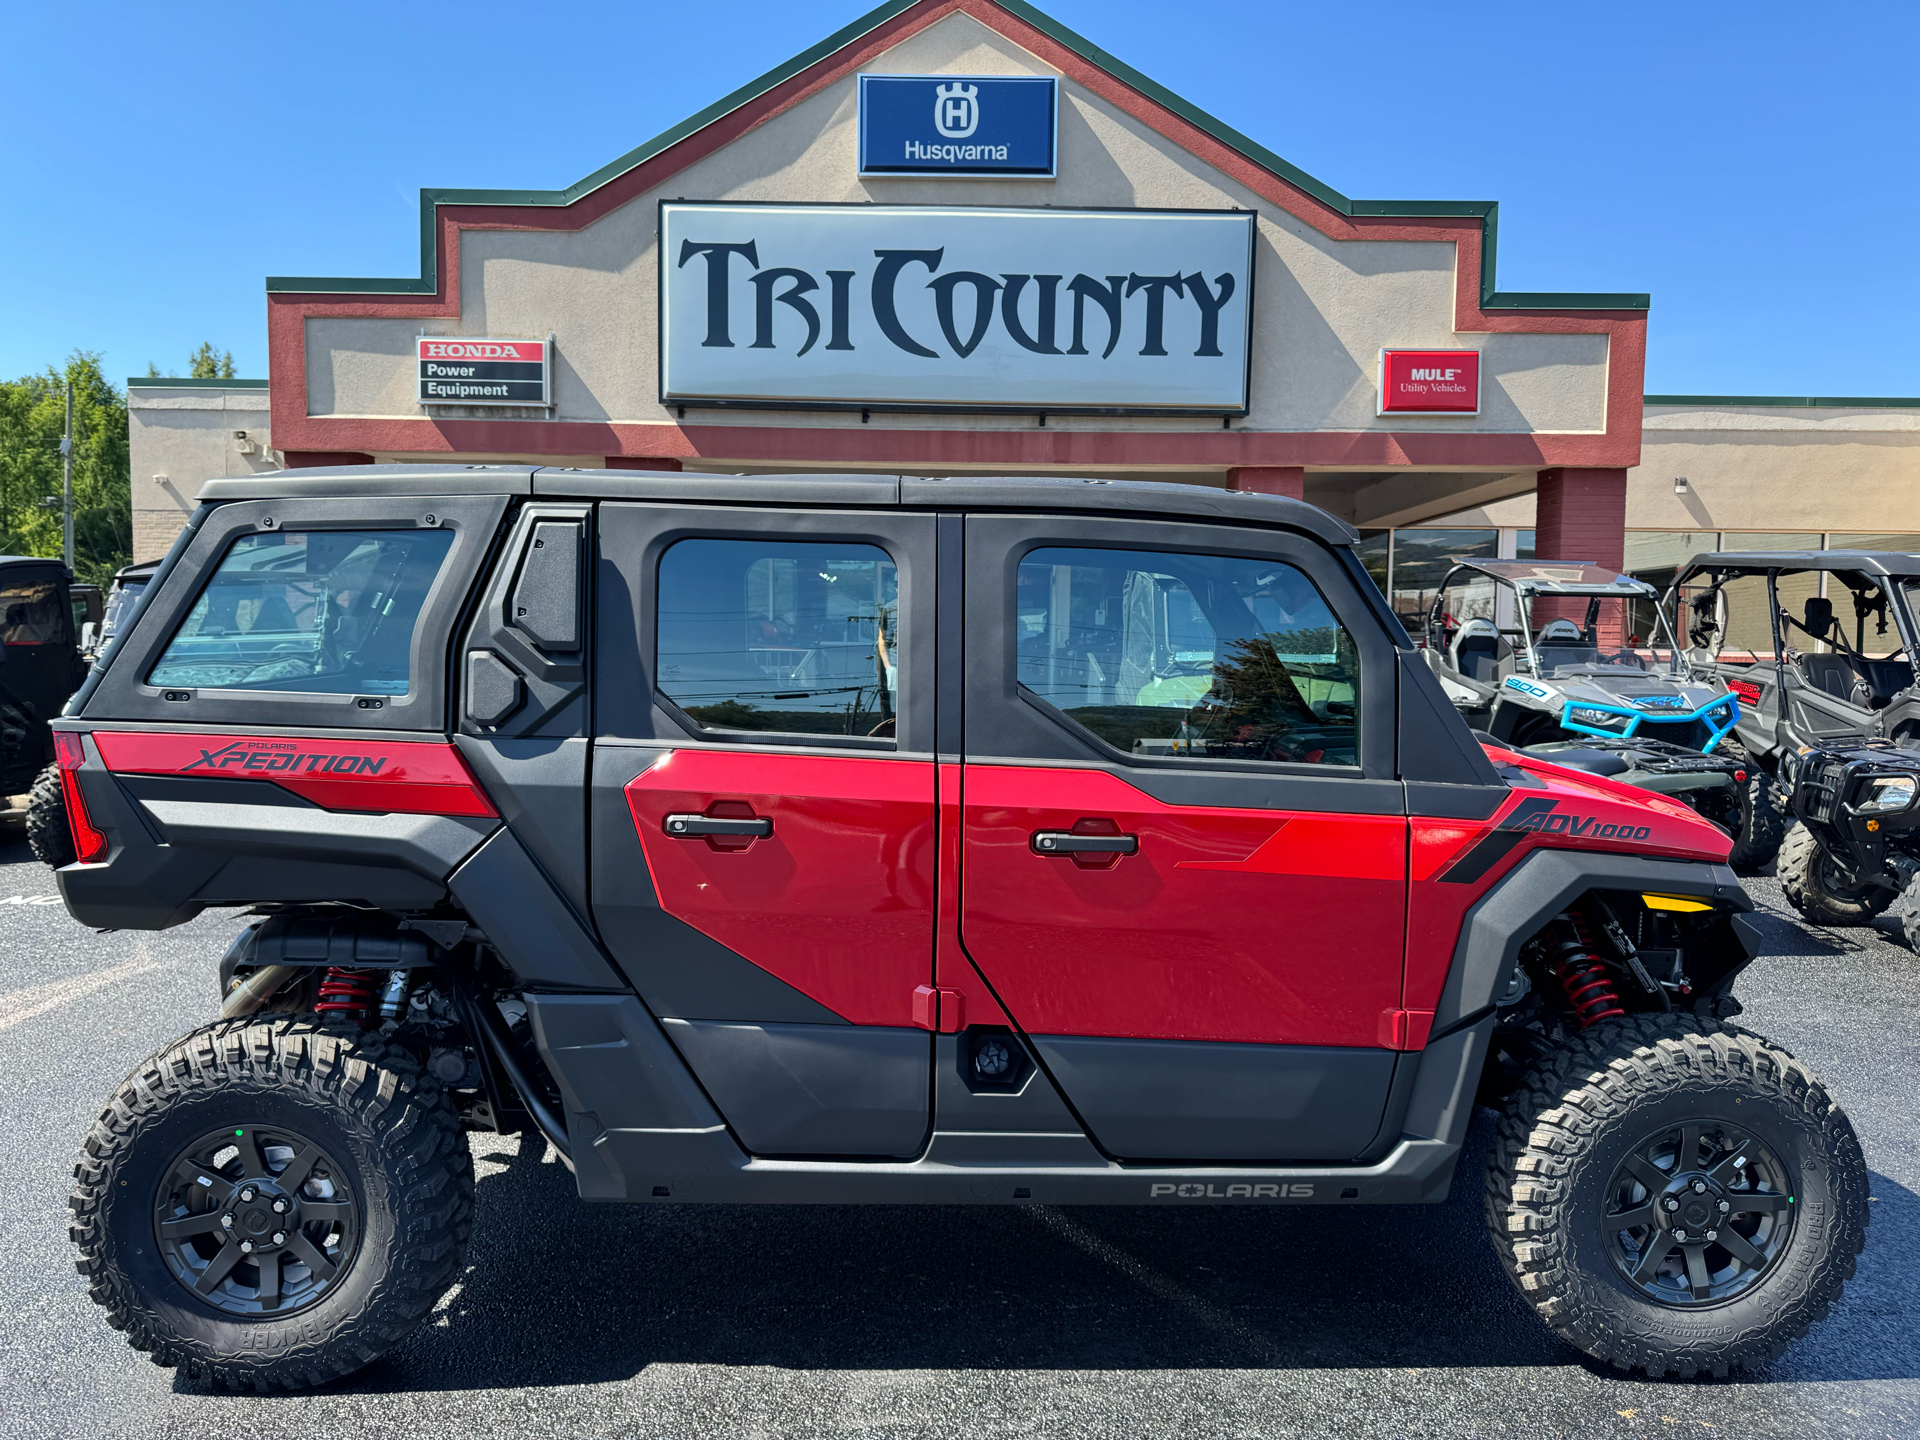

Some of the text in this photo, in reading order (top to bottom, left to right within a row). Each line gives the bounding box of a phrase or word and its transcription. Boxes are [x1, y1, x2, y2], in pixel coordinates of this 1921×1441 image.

[905, 140, 1008, 163] Husqvarna
[427, 344, 520, 357] HONDA
[427, 363, 475, 376] Power
[427, 382, 508, 397] Equipment
[1400, 383, 1466, 394] Utility Vehicles
[1506, 678, 1547, 698] 900
[248, 742, 297, 751] POLARIS
[177, 742, 388, 774] XPEDITION
[1150, 1183, 1314, 1198] POLARIS
